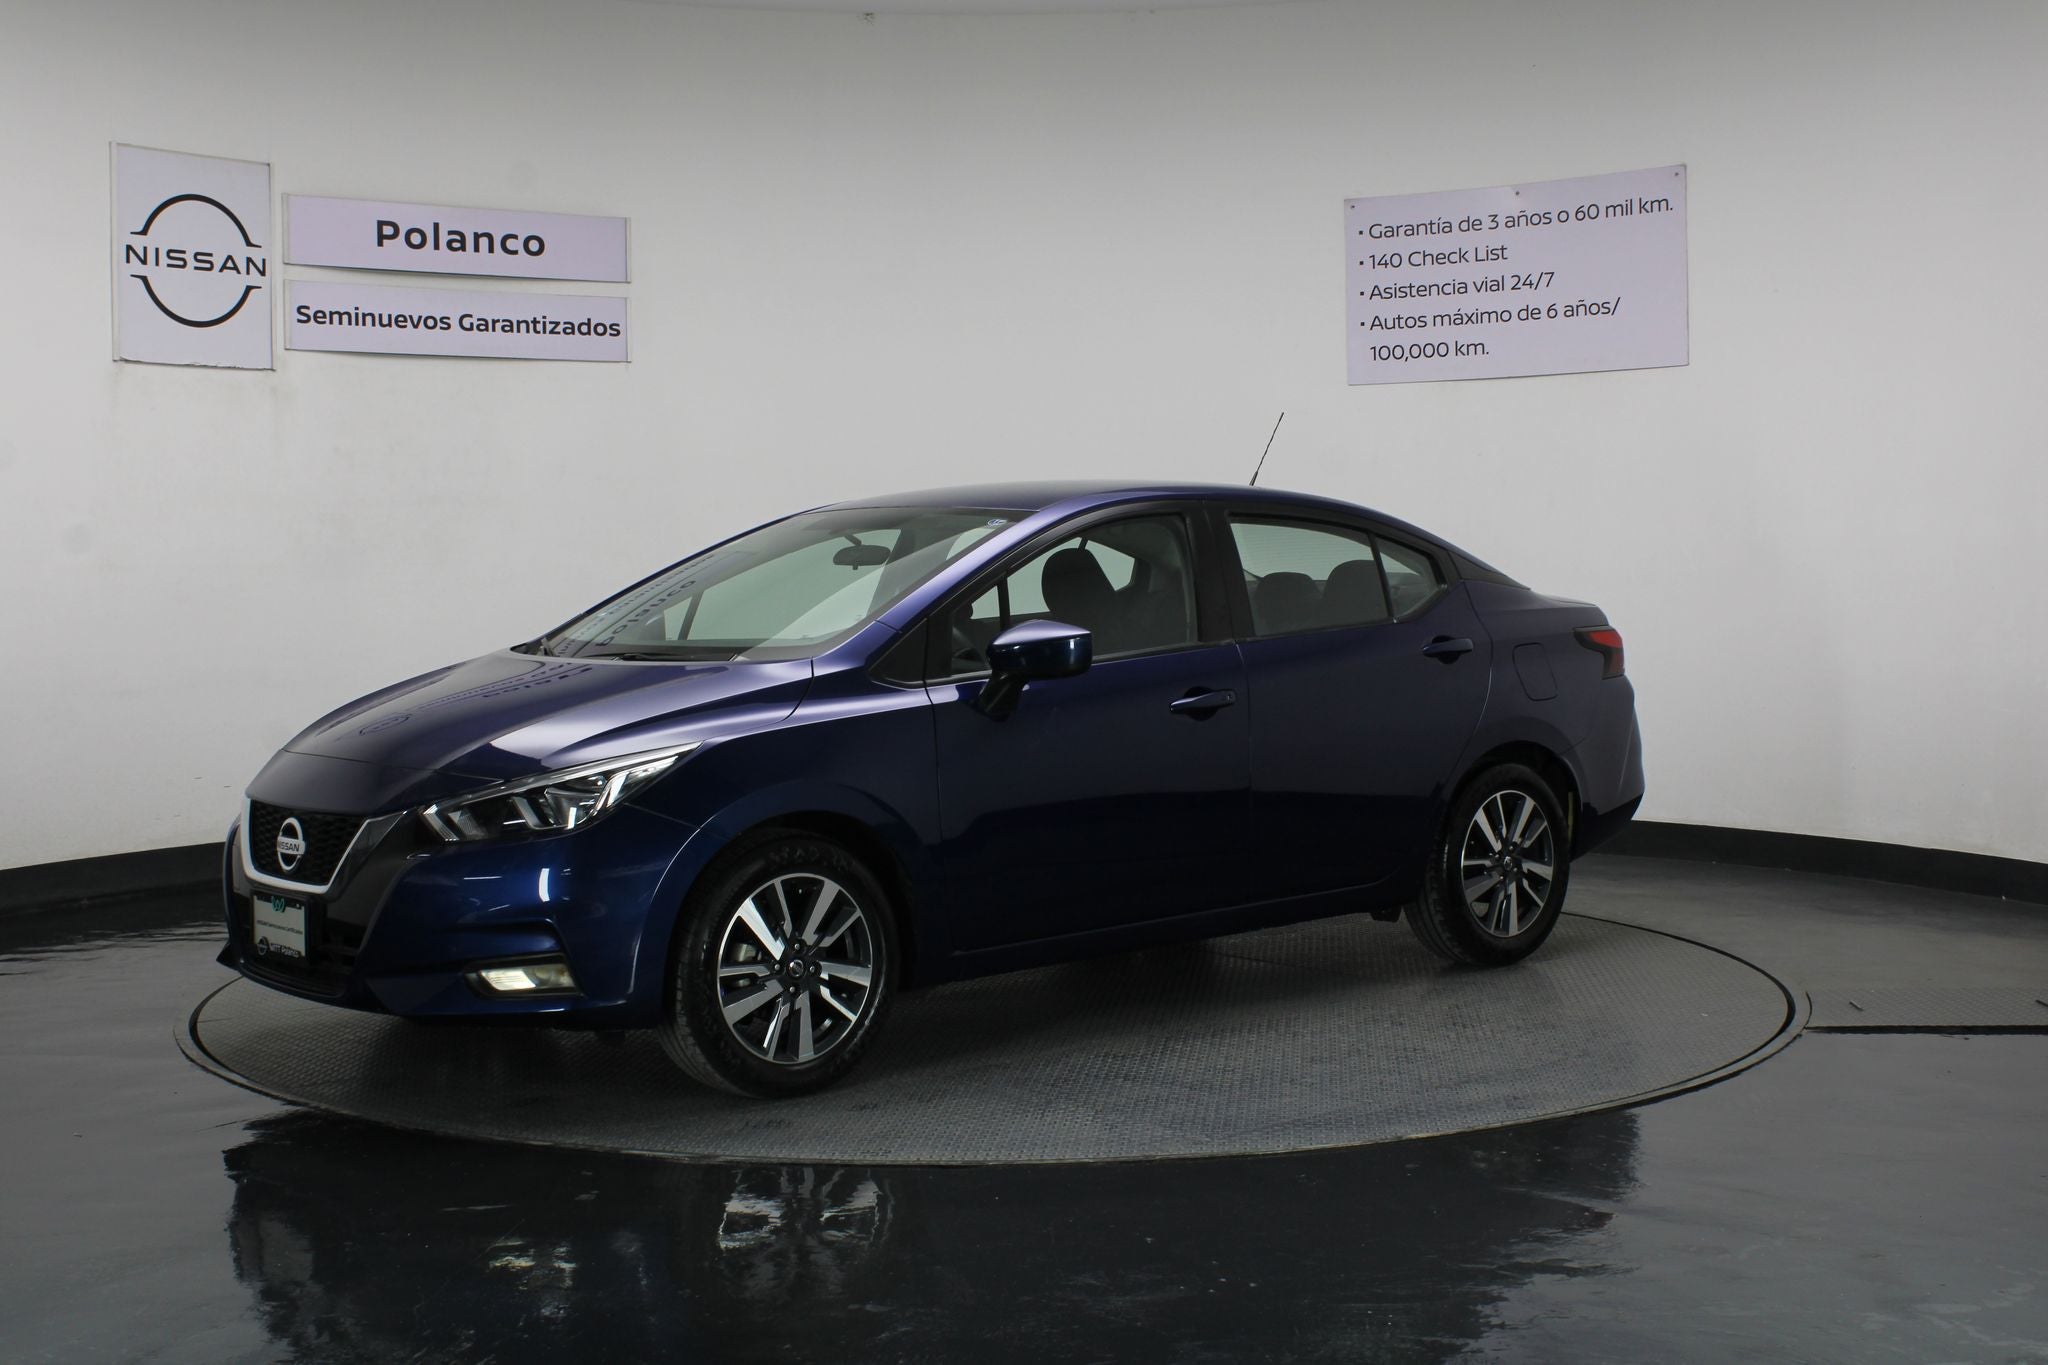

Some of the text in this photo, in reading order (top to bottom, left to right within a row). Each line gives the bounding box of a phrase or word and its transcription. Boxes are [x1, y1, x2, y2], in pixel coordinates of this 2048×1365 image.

[1368, 196, 1674, 240] Garantía de 3 años o 60 mil km.
[376, 219, 546, 257] Polanco
[126, 244, 267, 278] NISSAN
[1368, 244, 1509, 270] 140 Check List
[1368, 271, 1555, 301] Asistencia vial 24/7
[296, 304, 621, 338] Seminuevos Garantizados
[1369, 296, 1622, 331] Autos máximo de 6 años/
[1369, 339, 1490, 363] 100,000 km.
